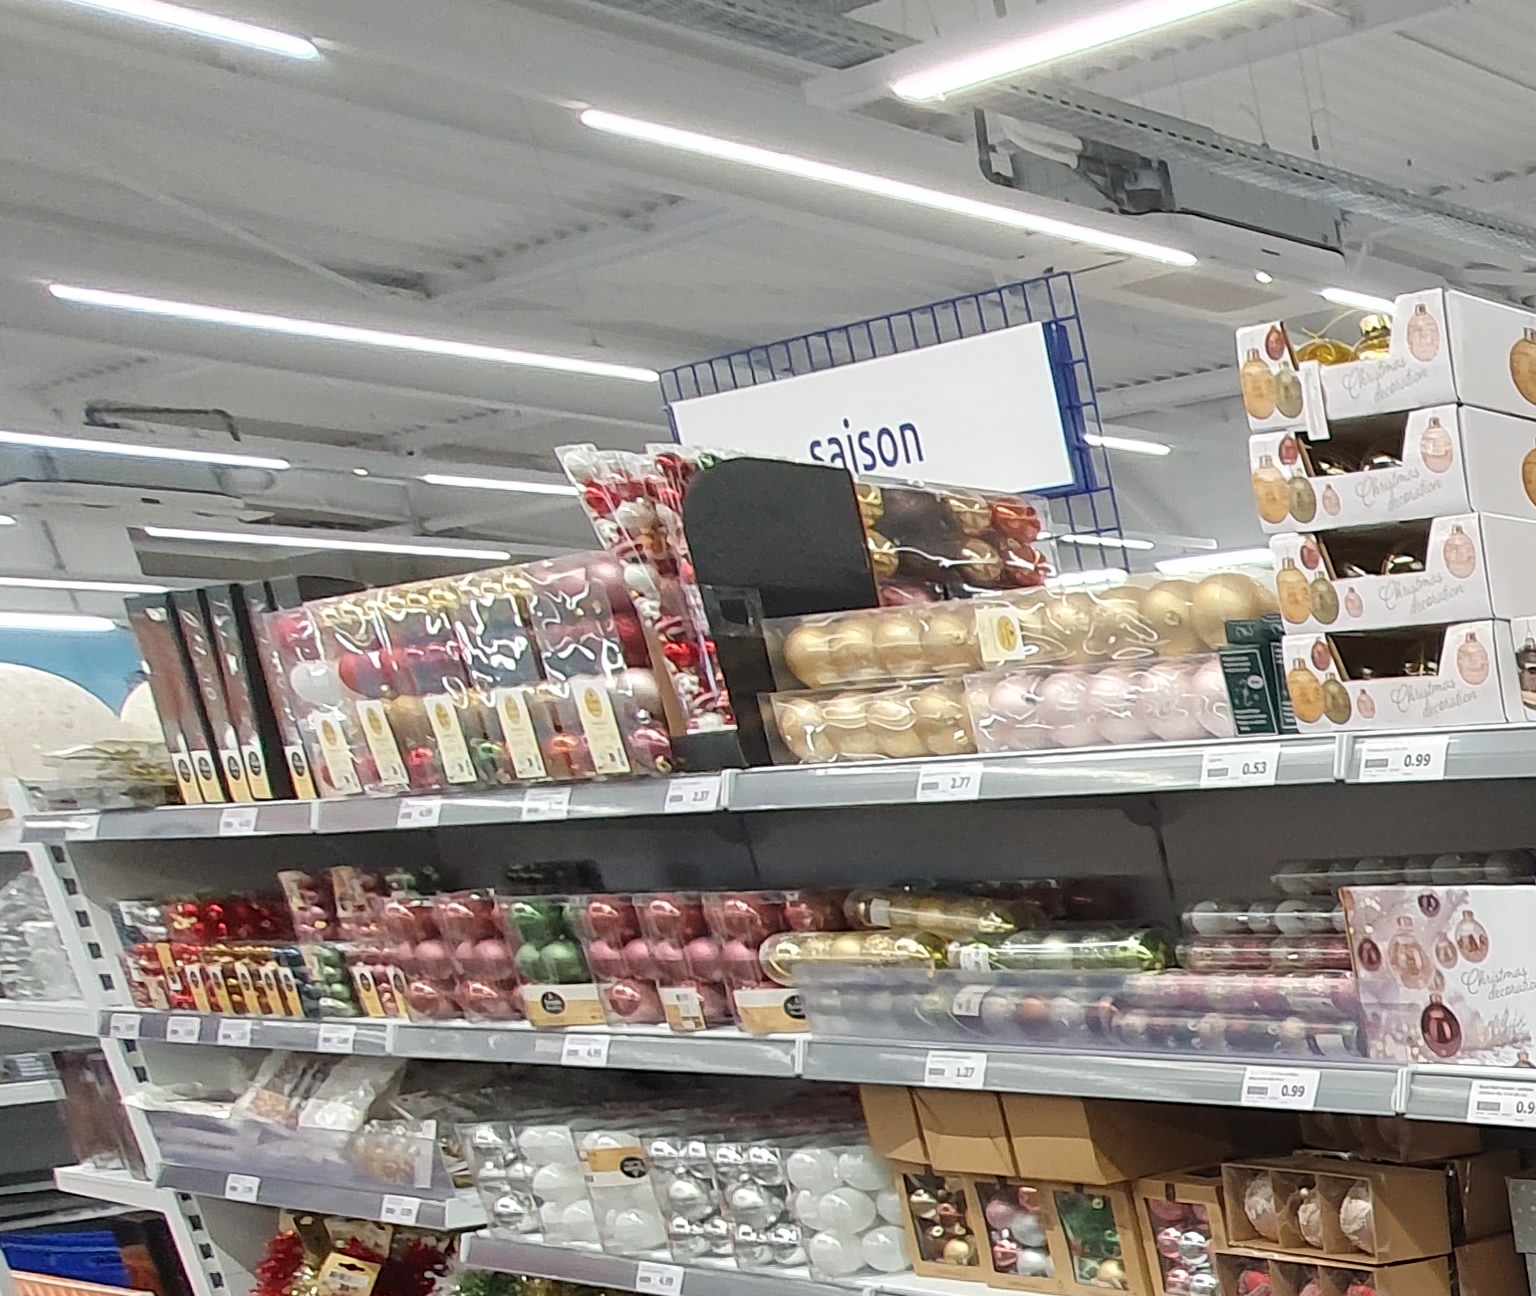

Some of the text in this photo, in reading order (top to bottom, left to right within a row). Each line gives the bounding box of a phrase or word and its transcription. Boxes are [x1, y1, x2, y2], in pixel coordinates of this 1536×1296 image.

[810, 418, 924, 475] saison
[1242, 761, 1267, 775] 0.53
[1403, 753, 1431, 768] 0.99
[1461, 966, 1528, 995] Christmas
[1281, 1084, 1305, 1097] 0.99
